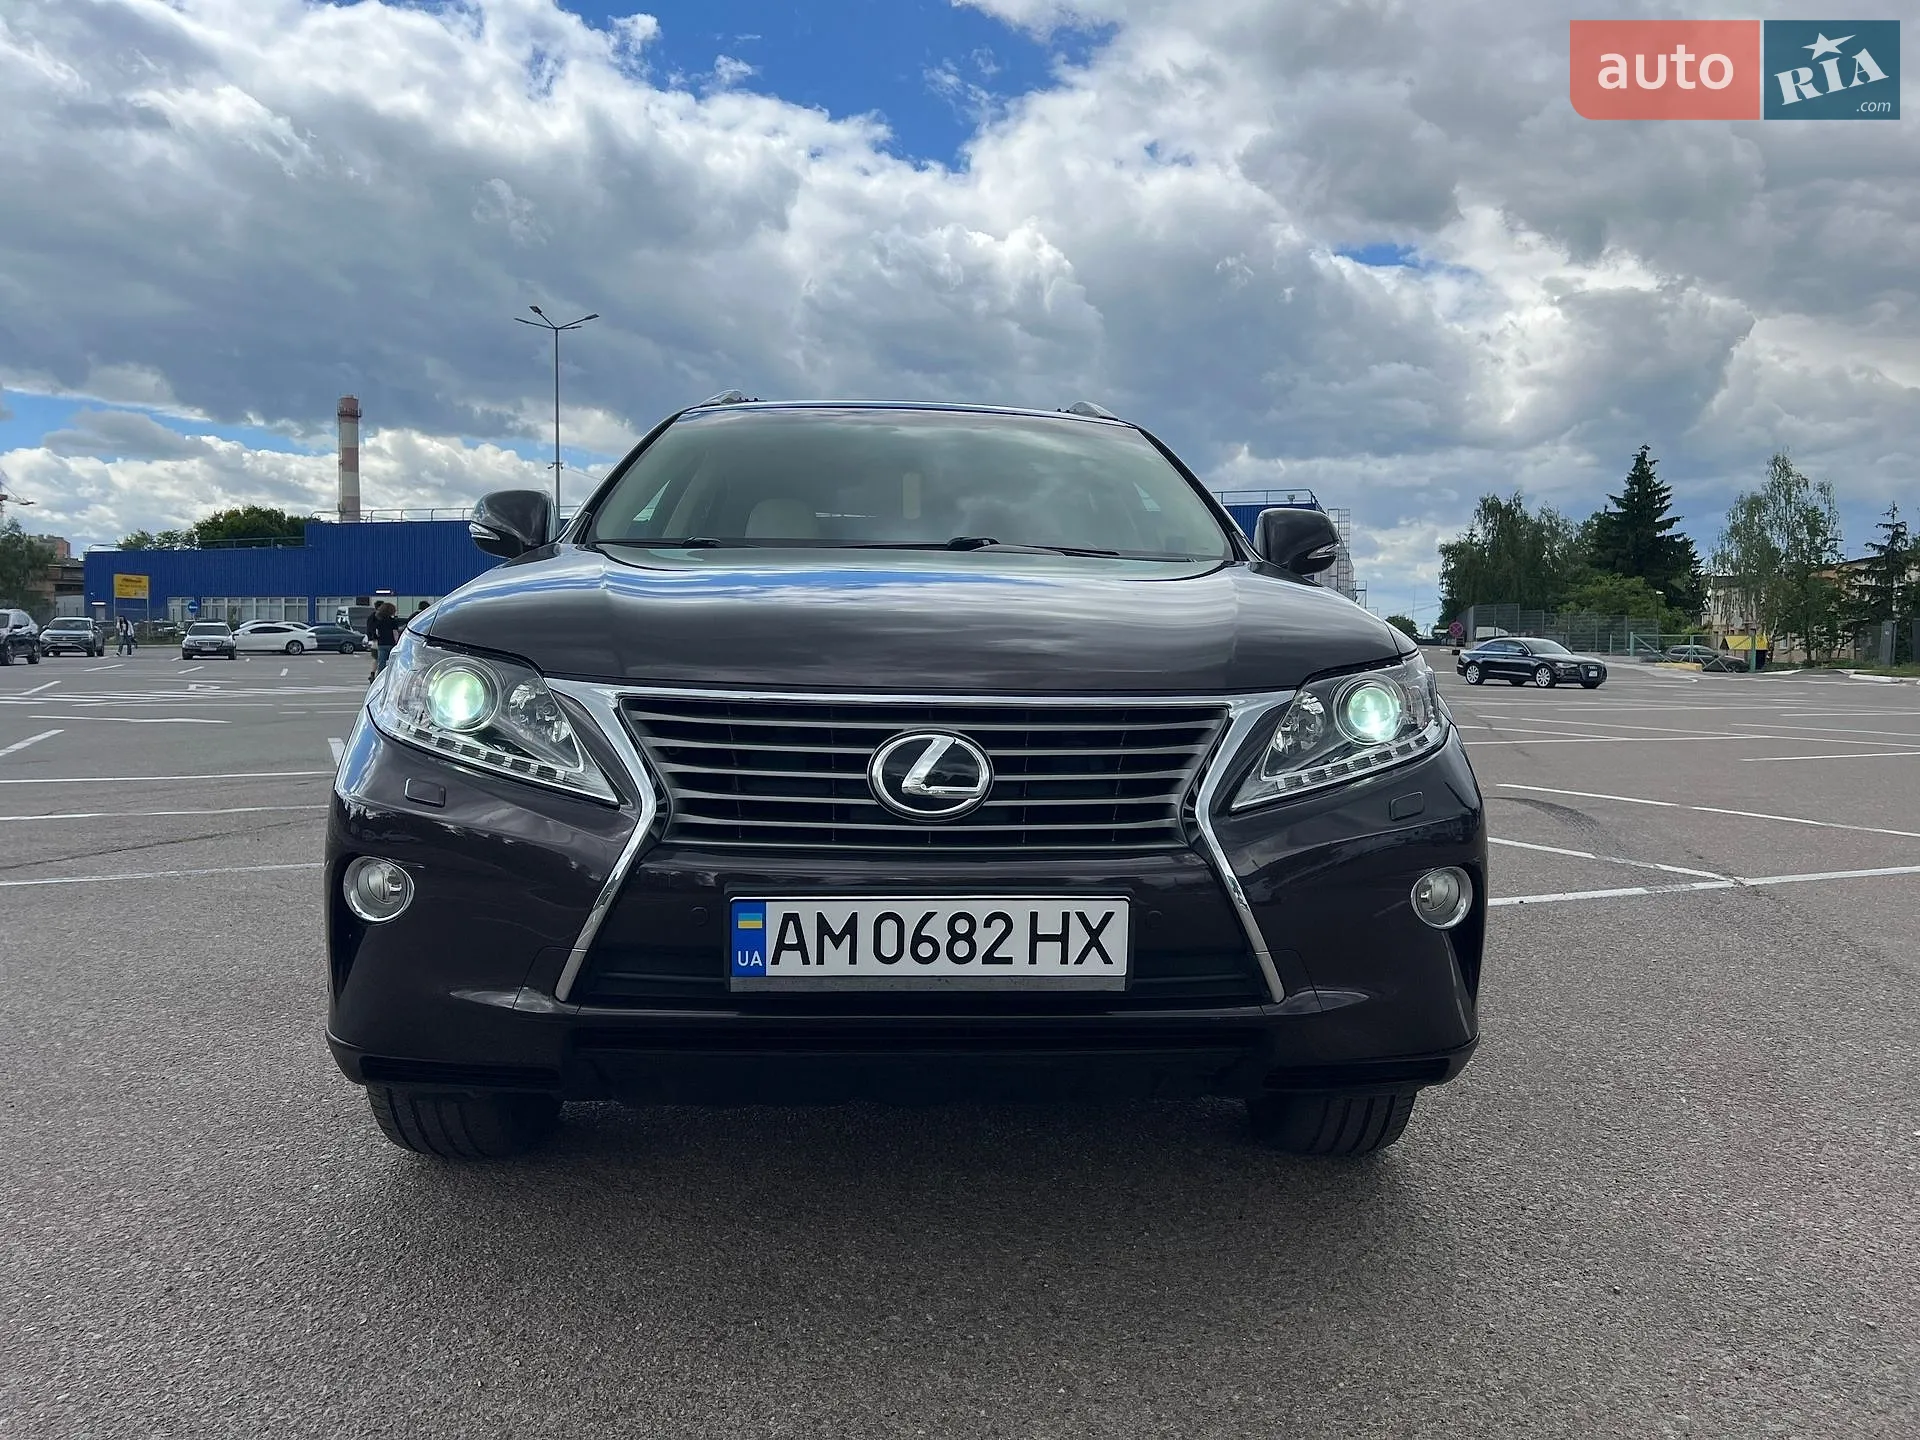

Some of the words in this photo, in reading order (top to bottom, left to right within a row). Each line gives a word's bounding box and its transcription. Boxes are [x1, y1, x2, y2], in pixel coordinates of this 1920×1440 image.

[770, 911, 858, 966] AM
[872, 911, 1014, 966] 0682
[1027, 911, 1116, 966] HX
[737, 950, 764, 967] UA
